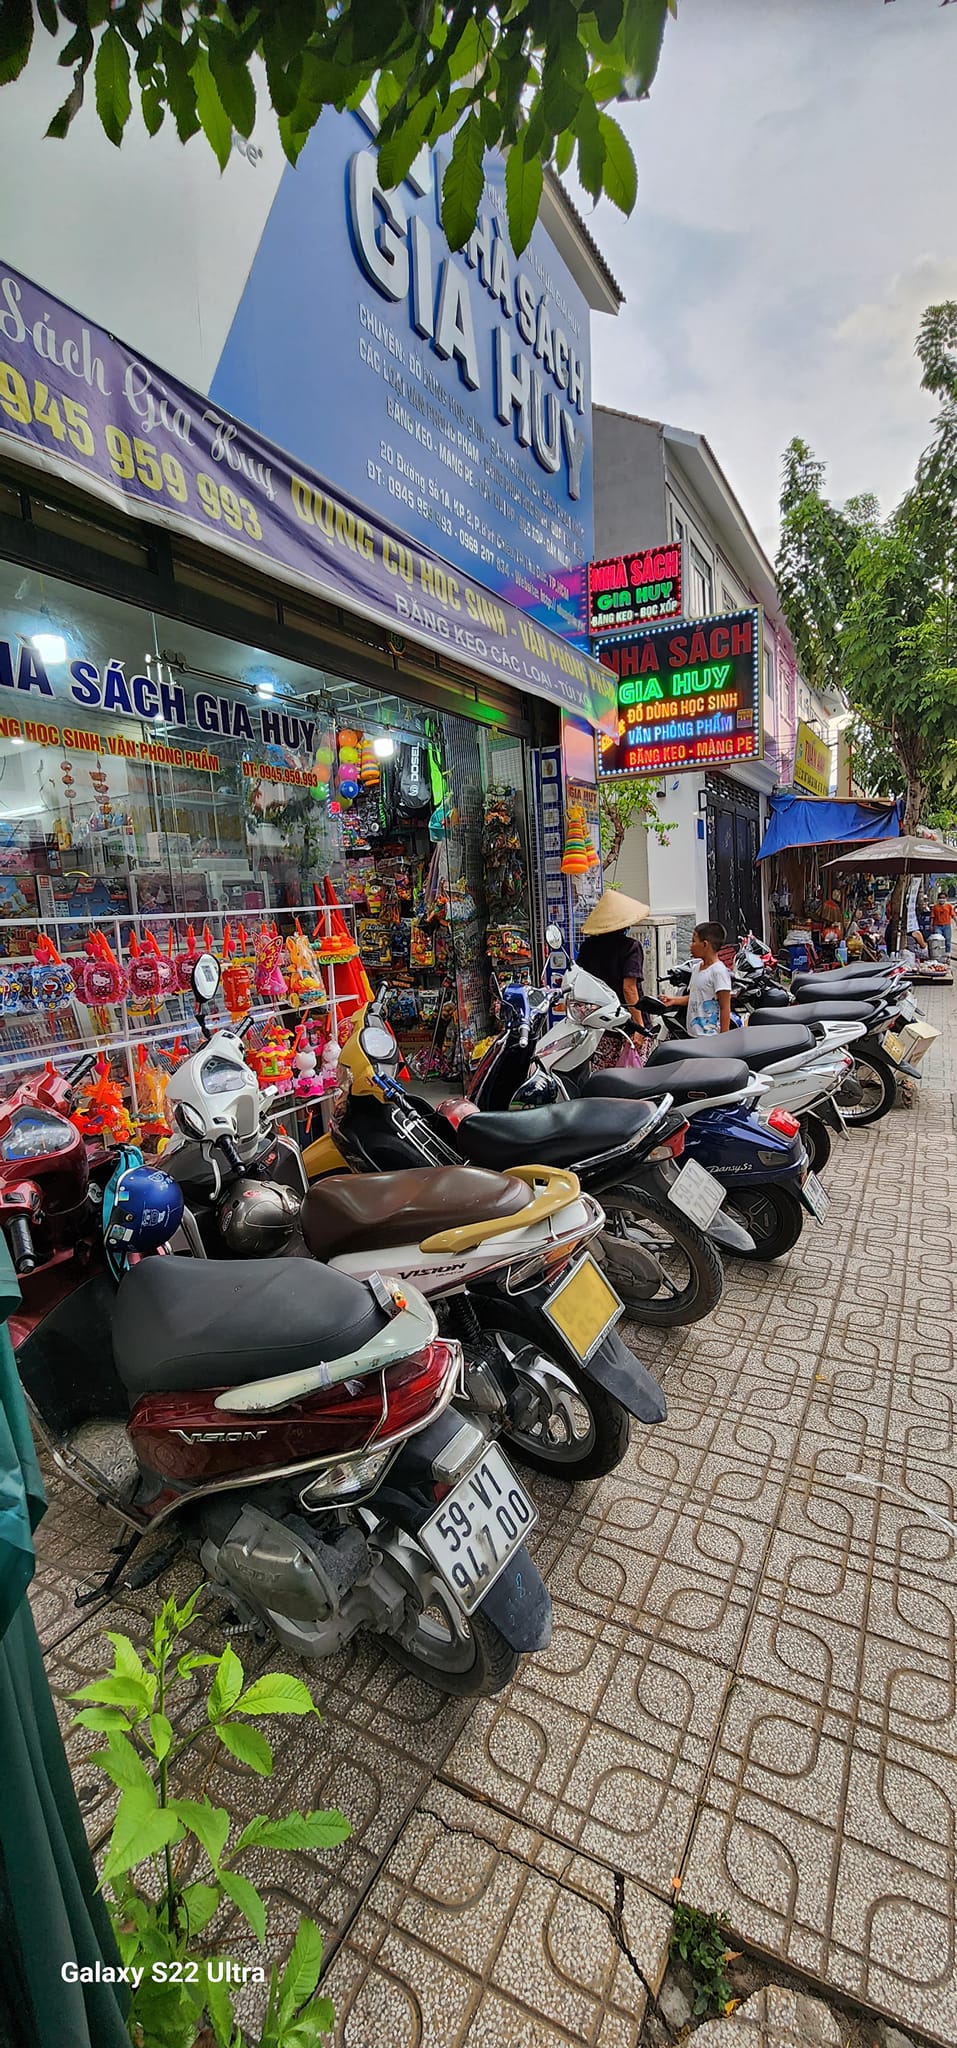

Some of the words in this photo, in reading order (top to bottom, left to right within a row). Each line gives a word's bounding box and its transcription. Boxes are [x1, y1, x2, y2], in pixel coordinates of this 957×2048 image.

[345, 150, 480, 391] GIA
[493, 325, 585, 501] HUY
[516, 272, 584, 416] SÁCH
[0, 278, 111, 395] Sách
[123, 362, 195, 446] Gia
[202, 410, 277, 500] Huy
[380, 440, 393, 465] 20
[415, 423, 431, 449] KEO
[464, 467, 472, 485] PE
[105, 424, 188, 503] 959
[196, 473, 263, 541] 993
[388, 476, 414, 509] 0945
[459, 528, 478, 554] 0969
[480, 544, 494, 566] 207
[291, 476, 375, 561] DỤNG
[382, 534, 415, 591] CỤ
[421, 554, 461, 612] HỌC
[465, 586, 508, 639] SINH
[519, 620, 548, 661] VĂN
[591, 558, 628, 592] NHÀ
[630, 550, 678, 586] SÁCH
[591, 611, 615, 627] BĂNG
[616, 607, 633, 622] KEO
[640, 603, 658, 619] BỌC
[659, 597, 677, 615] XỐP
[597, 591, 631, 610] GIA
[636, 581, 673, 604] HUY
[396, 594, 449, 638] BĂNG
[454, 626, 487, 657] KEO
[491, 645, 520, 672] CÁC
[523, 661, 552, 689] LOẠI
[559, 680, 576, 701] TÚI
[600, 638, 659, 677] NHÀ
[669, 620, 751, 668] SÁCH
[70, 658, 187, 727] SÁCH
[194, 692, 255, 743] GIA
[260, 709, 316, 752] HUY
[618, 677, 663, 705] GIA
[672, 665, 730, 696] HUY
[626, 706, 643, 724] ĐỒ
[646, 700, 677, 721] DÙNG
[681, 698, 704, 717] HỌC
[708, 692, 738, 710] SINH
[24, 720, 59, 747] HỌC
[63, 728, 106, 755] SINH,
[108, 734, 136, 759] VĂN
[139, 744, 183, 767] PHÒNG
[185, 747, 220, 772] PHẨM
[628, 725, 651, 745] VĂN
[654, 720, 694, 741] PHÒNG
[696, 712, 733, 734] PHẨM
[629, 748, 660, 766] BĂNG
[663, 745, 685, 763] KEO
[697, 738, 733, 757] MÀNG
[737, 736, 752, 752] PE
[242, 761, 257, 778] ĐT:
[259, 766, 318, 787] 0945.959.993
[397, 1263, 467, 1279] VISION
[168, 1429, 268, 1445] VISION
[436, 1463, 502, 1552] 59-V1
